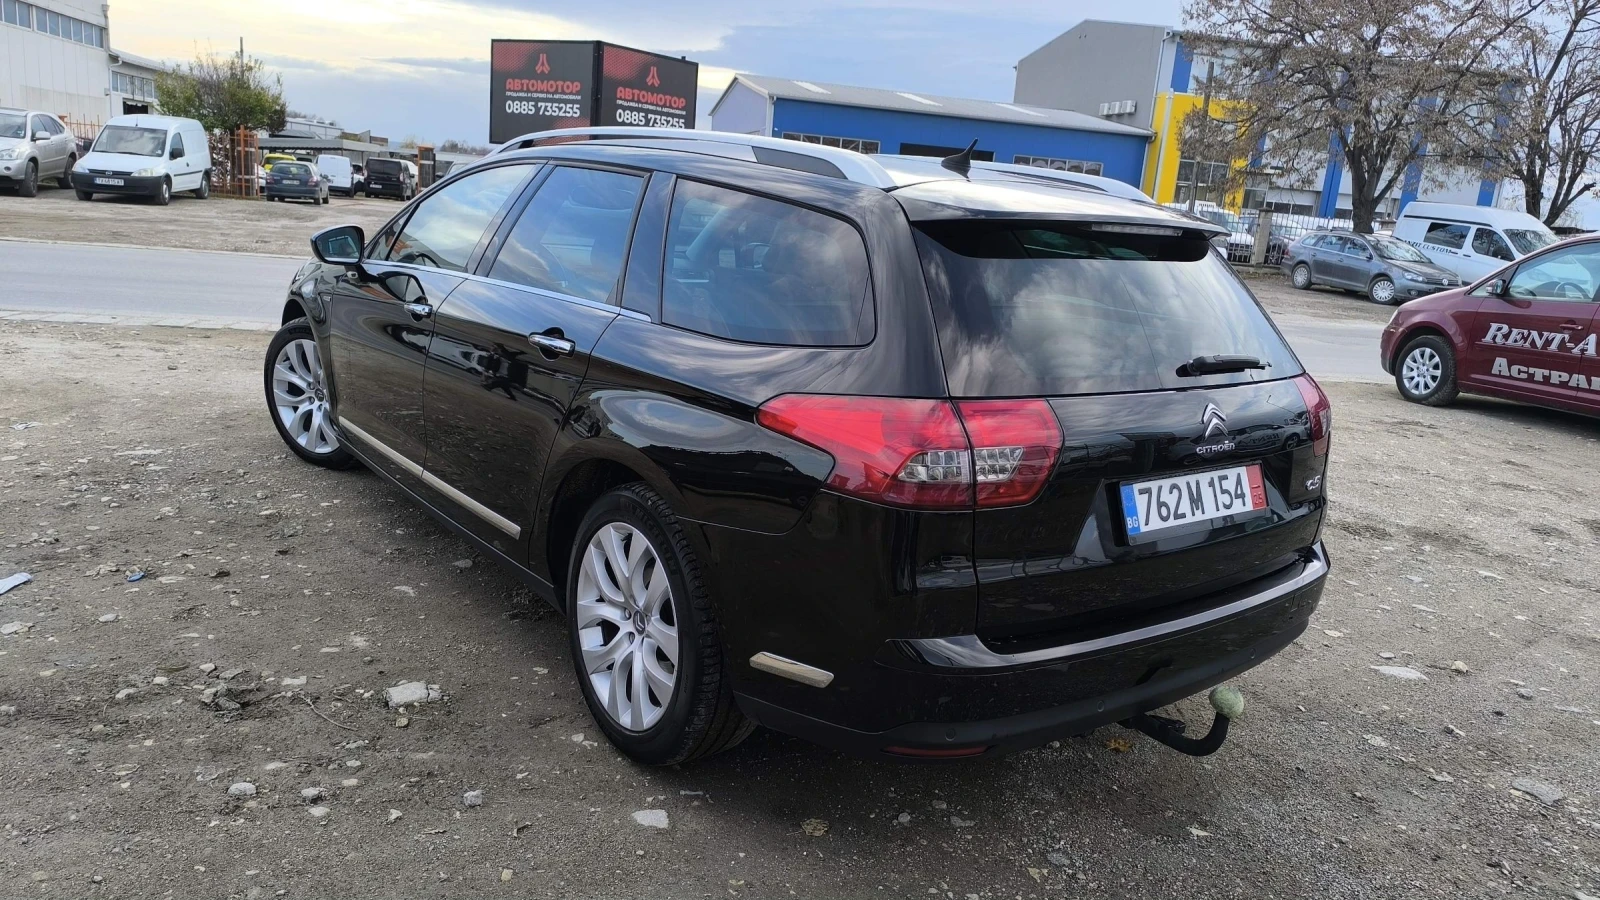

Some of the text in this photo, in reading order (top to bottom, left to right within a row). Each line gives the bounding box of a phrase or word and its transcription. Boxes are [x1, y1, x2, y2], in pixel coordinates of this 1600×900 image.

[505, 78, 581, 94] АВТОМОТОР
[616, 86, 687, 109] АВТОМОТОР
[505, 100, 581, 117] 0885 735255
[616, 108, 685, 129] 0885 735255
[1481, 322, 1598, 357] RENT-A
[1196, 440, 1235, 454] CITROËN
[1138, 472, 1246, 526] 762M 154
[1127, 516, 1139, 529] BG
